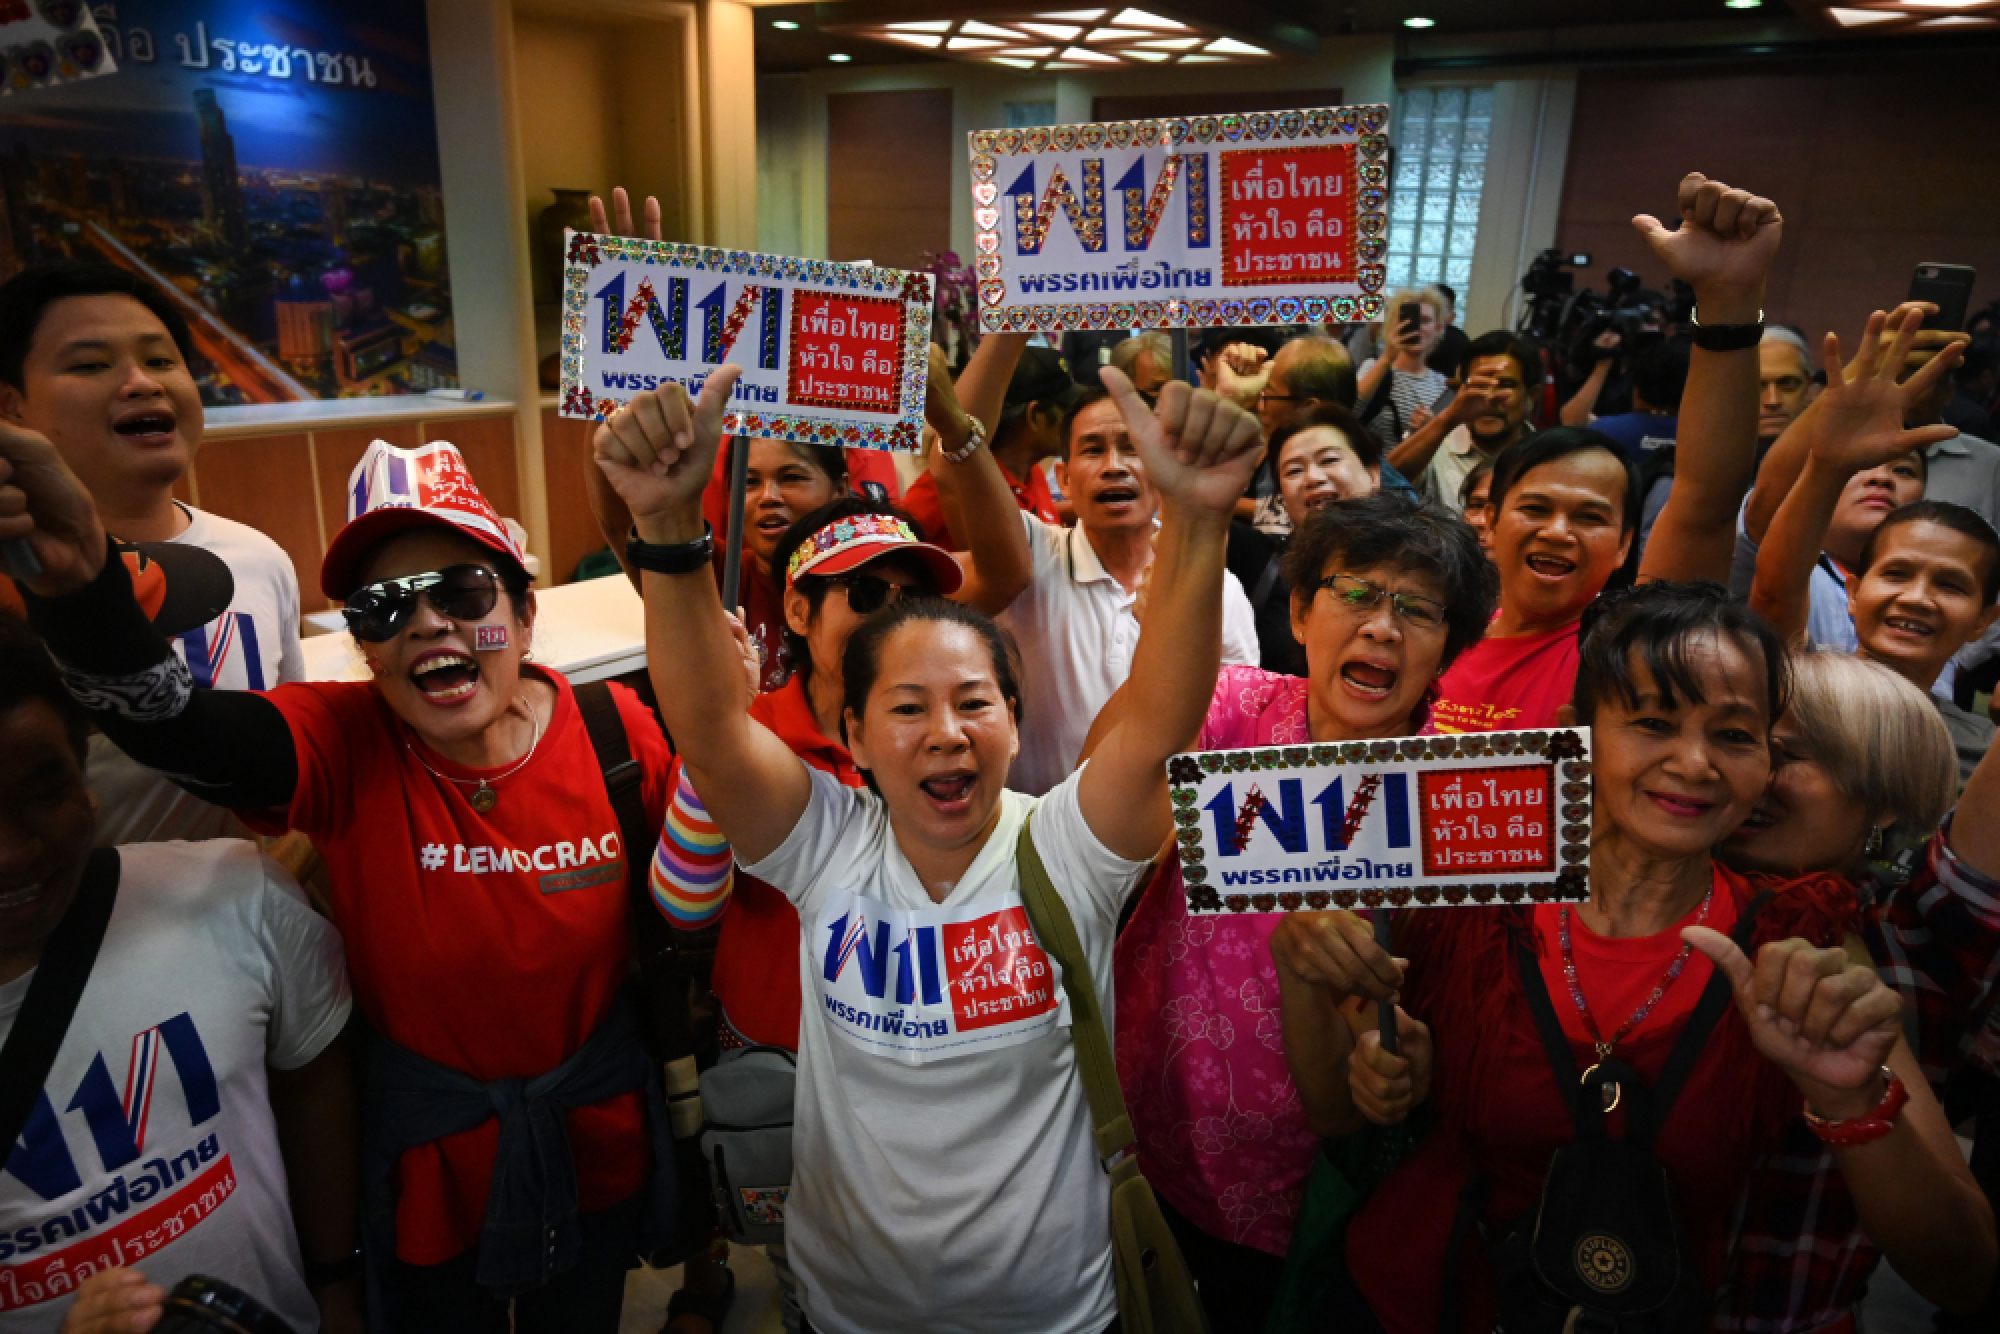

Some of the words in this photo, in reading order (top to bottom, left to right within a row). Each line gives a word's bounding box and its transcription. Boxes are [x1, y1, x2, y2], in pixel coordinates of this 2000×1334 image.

[174, 20, 378, 89] ประชาชน
[1231, 157, 1344, 201] เพื่อไทย
[1231, 207, 1298, 241] หัวใจ
[1305, 207, 1344, 239] คือ
[1017, 255, 1213, 295] พรรคเพื่อไทย
[1232, 246, 1343, 273] ประชาชน
[800, 299, 896, 342] เพื่อไทย
[799, 341, 855, 371] หัวใจ
[860, 348, 893, 376] คือ
[798, 373, 890, 402] ประชาชน
[1430, 775, 1544, 810] เพื่อไทย
[1431, 813, 1498, 841] หัวใจ
[1506, 813, 1544, 839] คือ
[419, 831, 621, 875] #DEMOCRAC
[1433, 846, 1543, 866] ประชาชน
[1220, 855, 1415, 888] พรรคเพื่อไทย
[963, 987, 1048, 1019] ประชาชน
